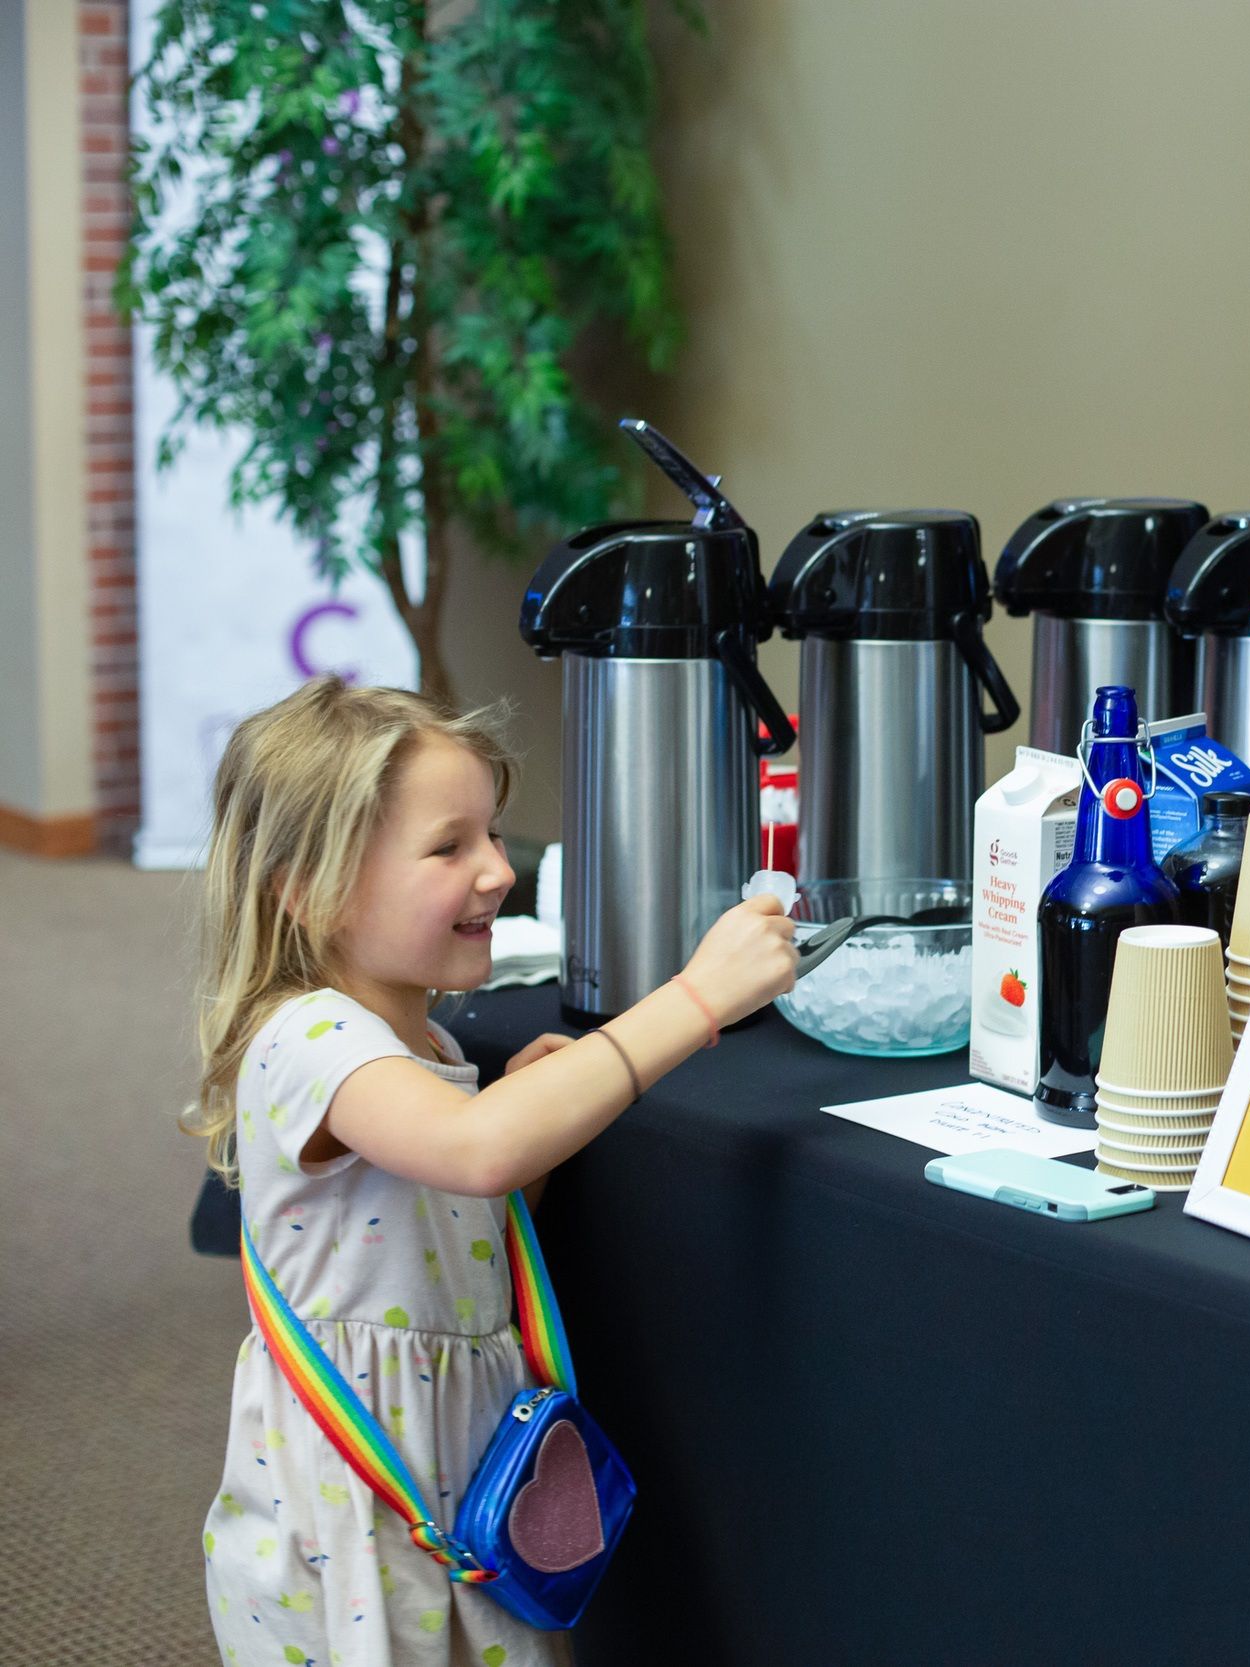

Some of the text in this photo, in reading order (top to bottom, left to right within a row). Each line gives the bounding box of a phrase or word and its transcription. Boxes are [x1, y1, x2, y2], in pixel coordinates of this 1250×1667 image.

[1170, 745, 1233, 787] Silk
[990, 875, 1017, 896] Heavy
[982, 889, 1026, 913] Whipping
[988, 906, 1018, 924] Cream
